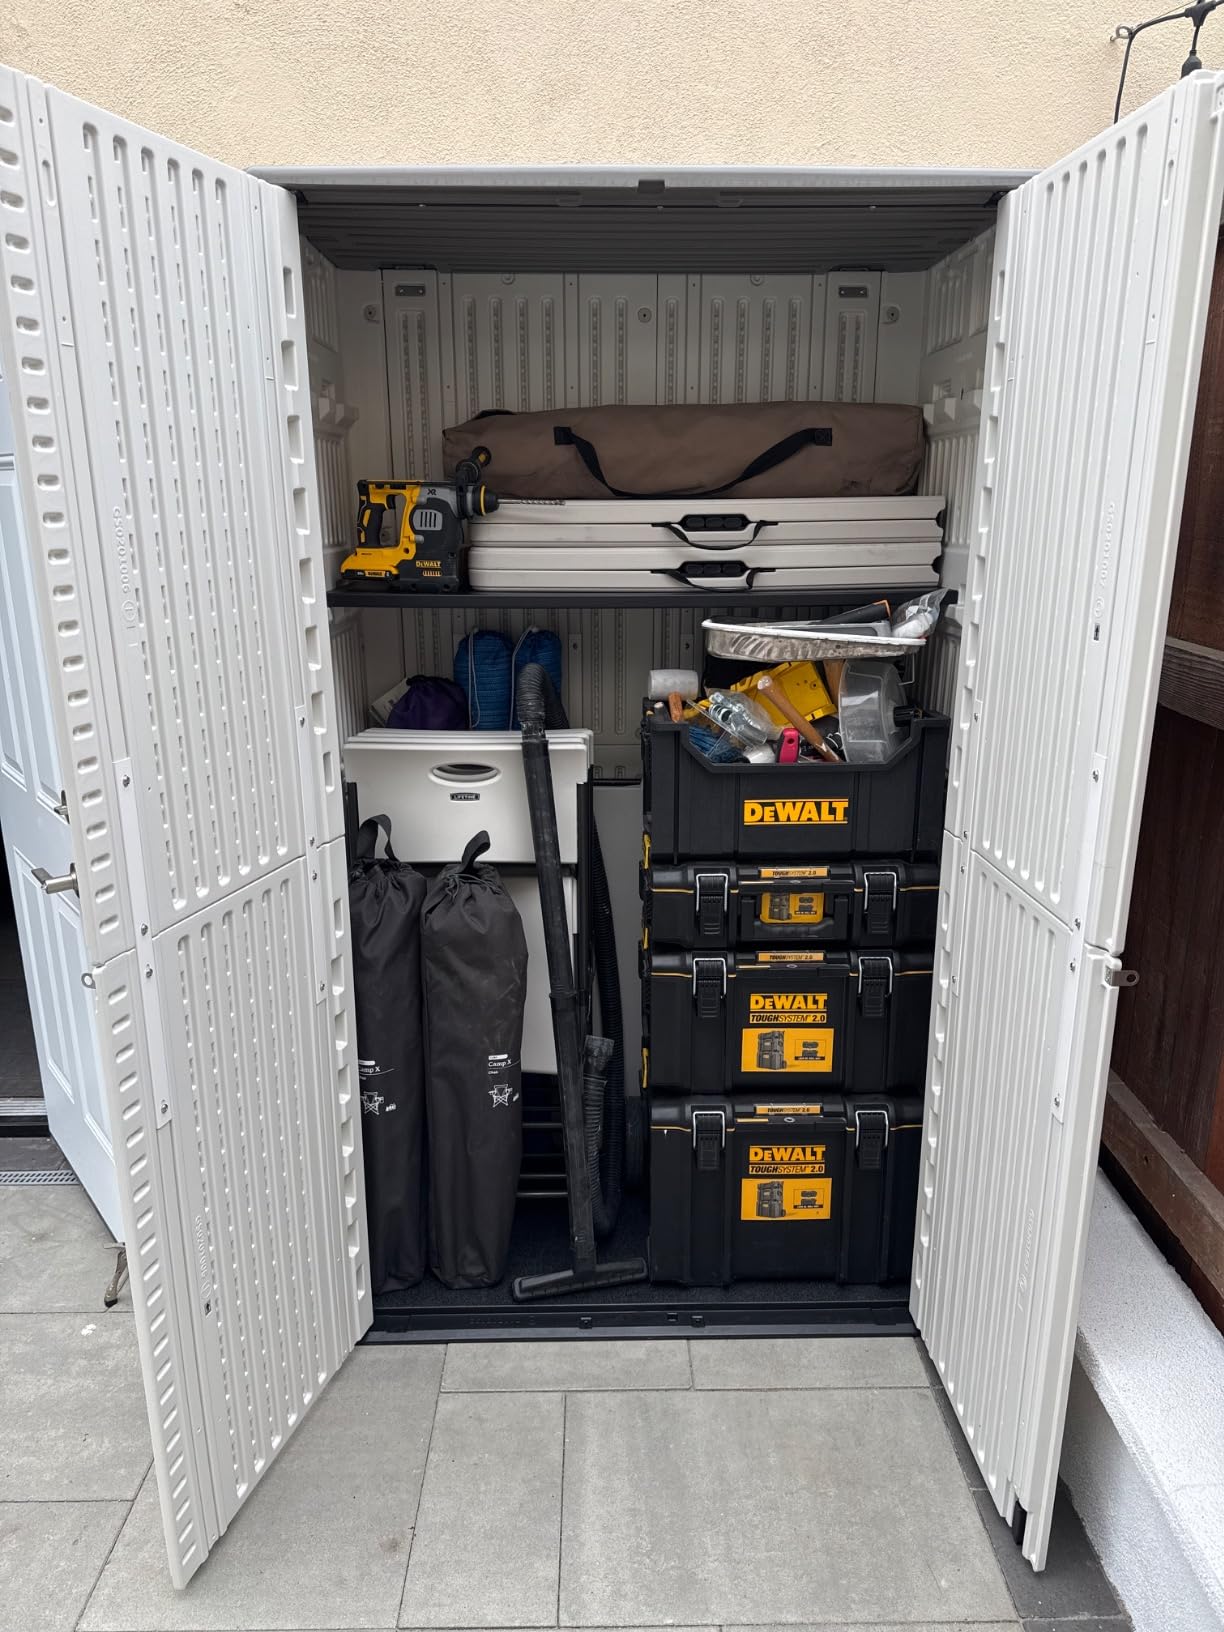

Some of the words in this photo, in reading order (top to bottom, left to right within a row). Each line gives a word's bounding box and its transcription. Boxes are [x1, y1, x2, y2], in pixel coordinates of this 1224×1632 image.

[744, 801, 848, 822] DEWALT
[750, 995, 827, 1009] DEWALT
[813, 1014, 825, 1022] 2.0
[749, 1147, 826, 1161] DEWALT
